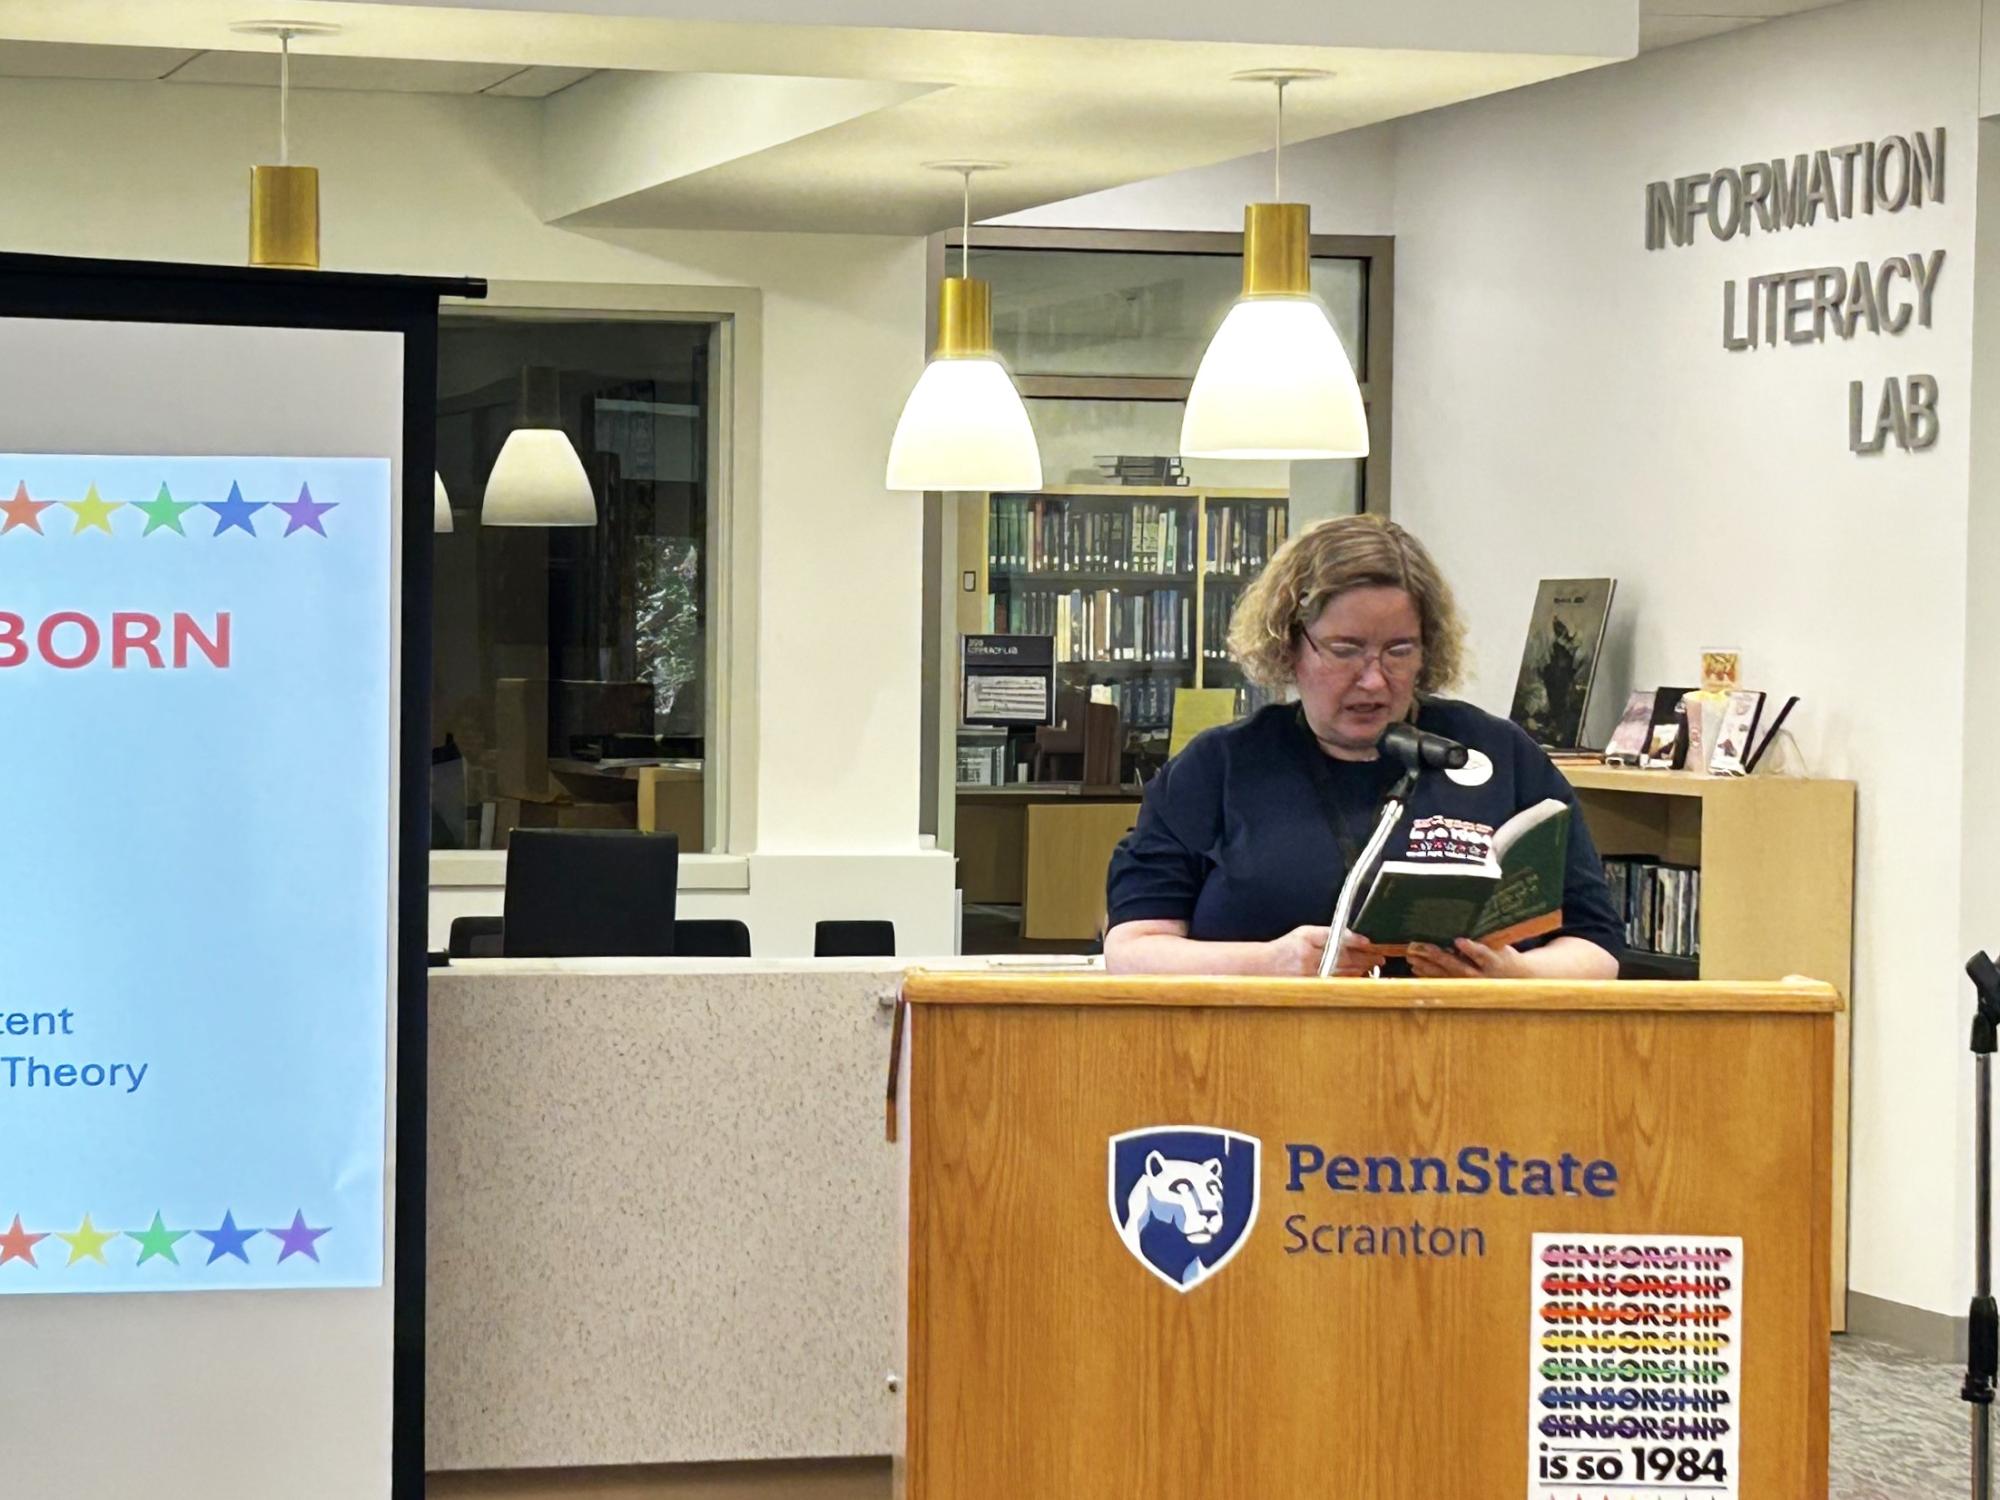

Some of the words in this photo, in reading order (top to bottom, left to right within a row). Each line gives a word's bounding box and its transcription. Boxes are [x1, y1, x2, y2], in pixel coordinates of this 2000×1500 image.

[1645, 127, 1946, 251] INFORMATION
[1723, 250, 1946, 351] LITERACY
[1849, 373, 1940, 455] LAB
[0, 611, 230, 669] BORN
[0, 1056, 148, 1093] Theory
[1284, 1143, 1619, 1197] PennState
[1284, 1214, 1486, 1257] Scranton
[1541, 1244, 1732, 1270] CENSORSHIP
[1542, 1273, 1731, 1299] CENSORSHIP
[1541, 1301, 1731, 1327] CENSORSHIP
[1541, 1329, 1730, 1355] CENSORSHIP
[1540, 1357, 1730, 1384] CENSORSHIP
[1539, 1386, 1730, 1412] CENSORSHIP
[1539, 1414, 1731, 1441] CENSORSHIP
[1539, 1442, 1568, 1480] is
[1576, 1455, 1624, 1480] so
[1632, 1447, 1728, 1482] 1984
